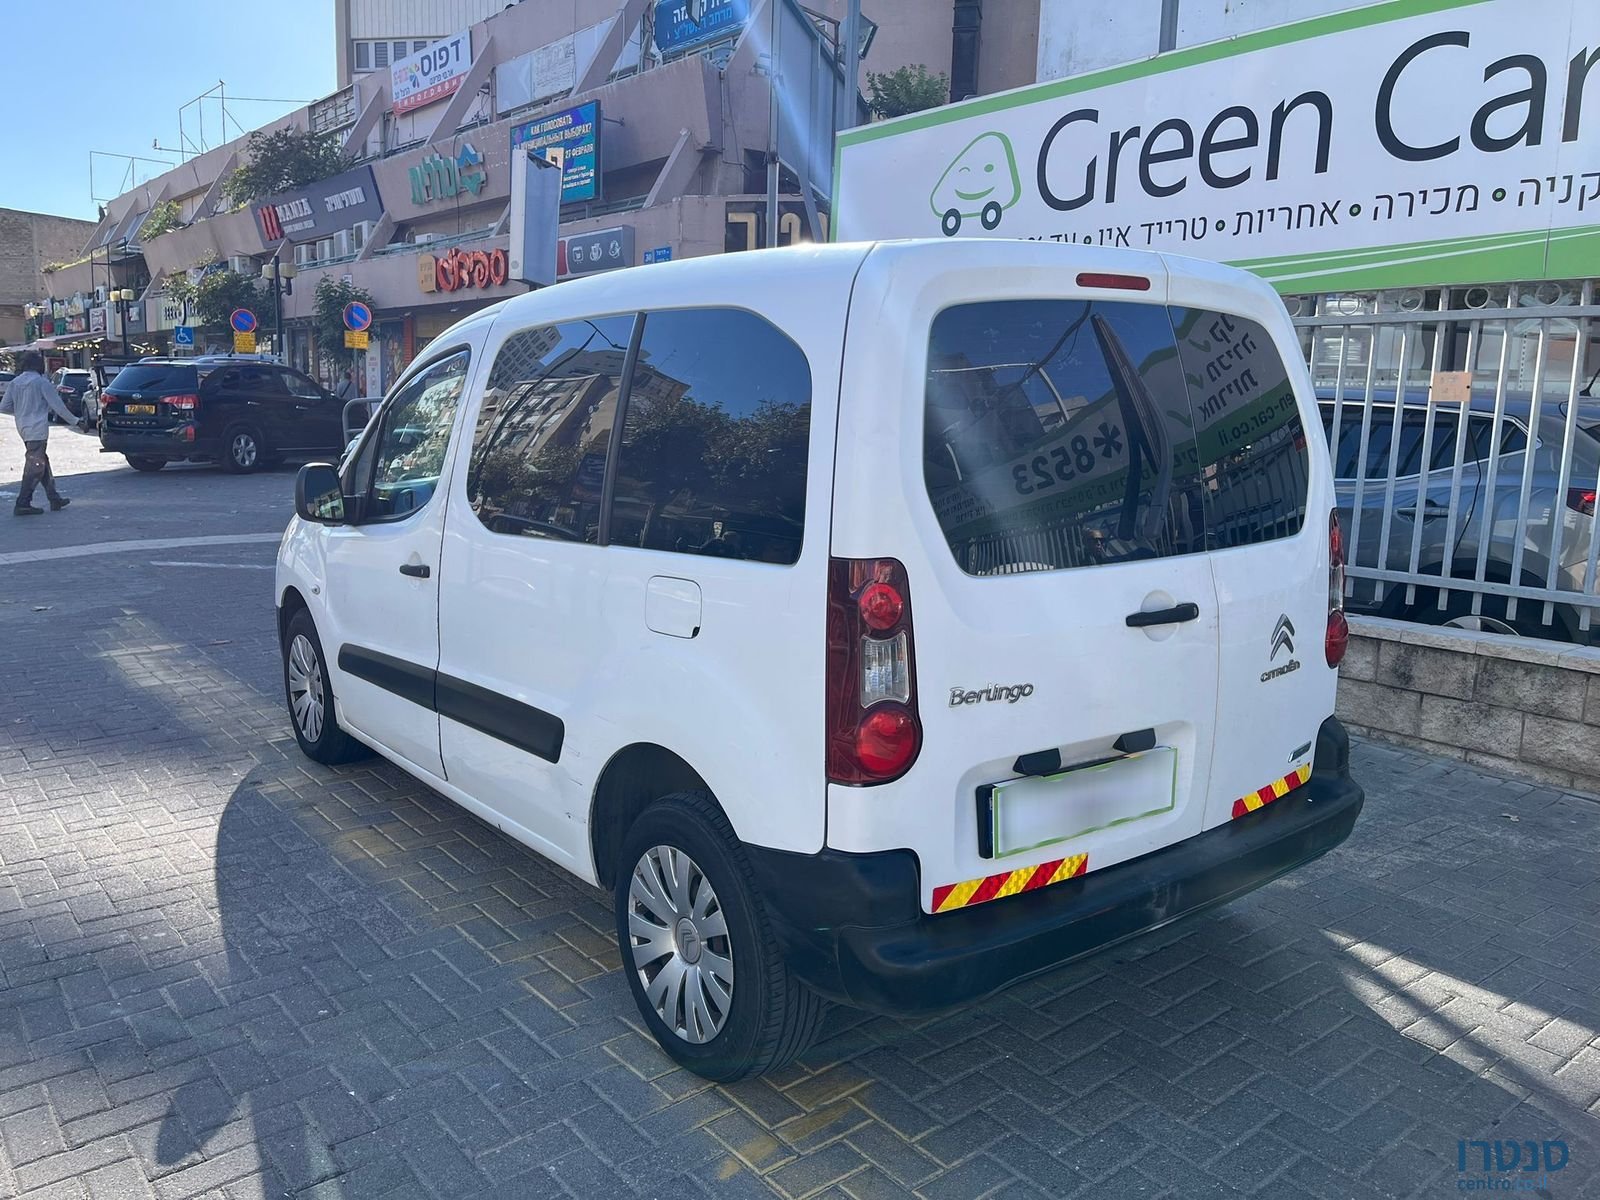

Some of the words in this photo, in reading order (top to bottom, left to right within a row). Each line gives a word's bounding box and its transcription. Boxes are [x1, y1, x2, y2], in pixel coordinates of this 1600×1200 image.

[420, 38, 461, 77] דפוס
[1037, 91, 1332, 211] Green
[1375, 31, 1600, 161] Car
[275, 197, 313, 223] MANIA
[1372, 184, 1479, 221] מכירה
[1517, 173, 1600, 212] קניה
[1140, 216, 1208, 245] טרייד
[1232, 200, 1342, 237] אחריות
[948, 682, 1034, 708] Berlingo
